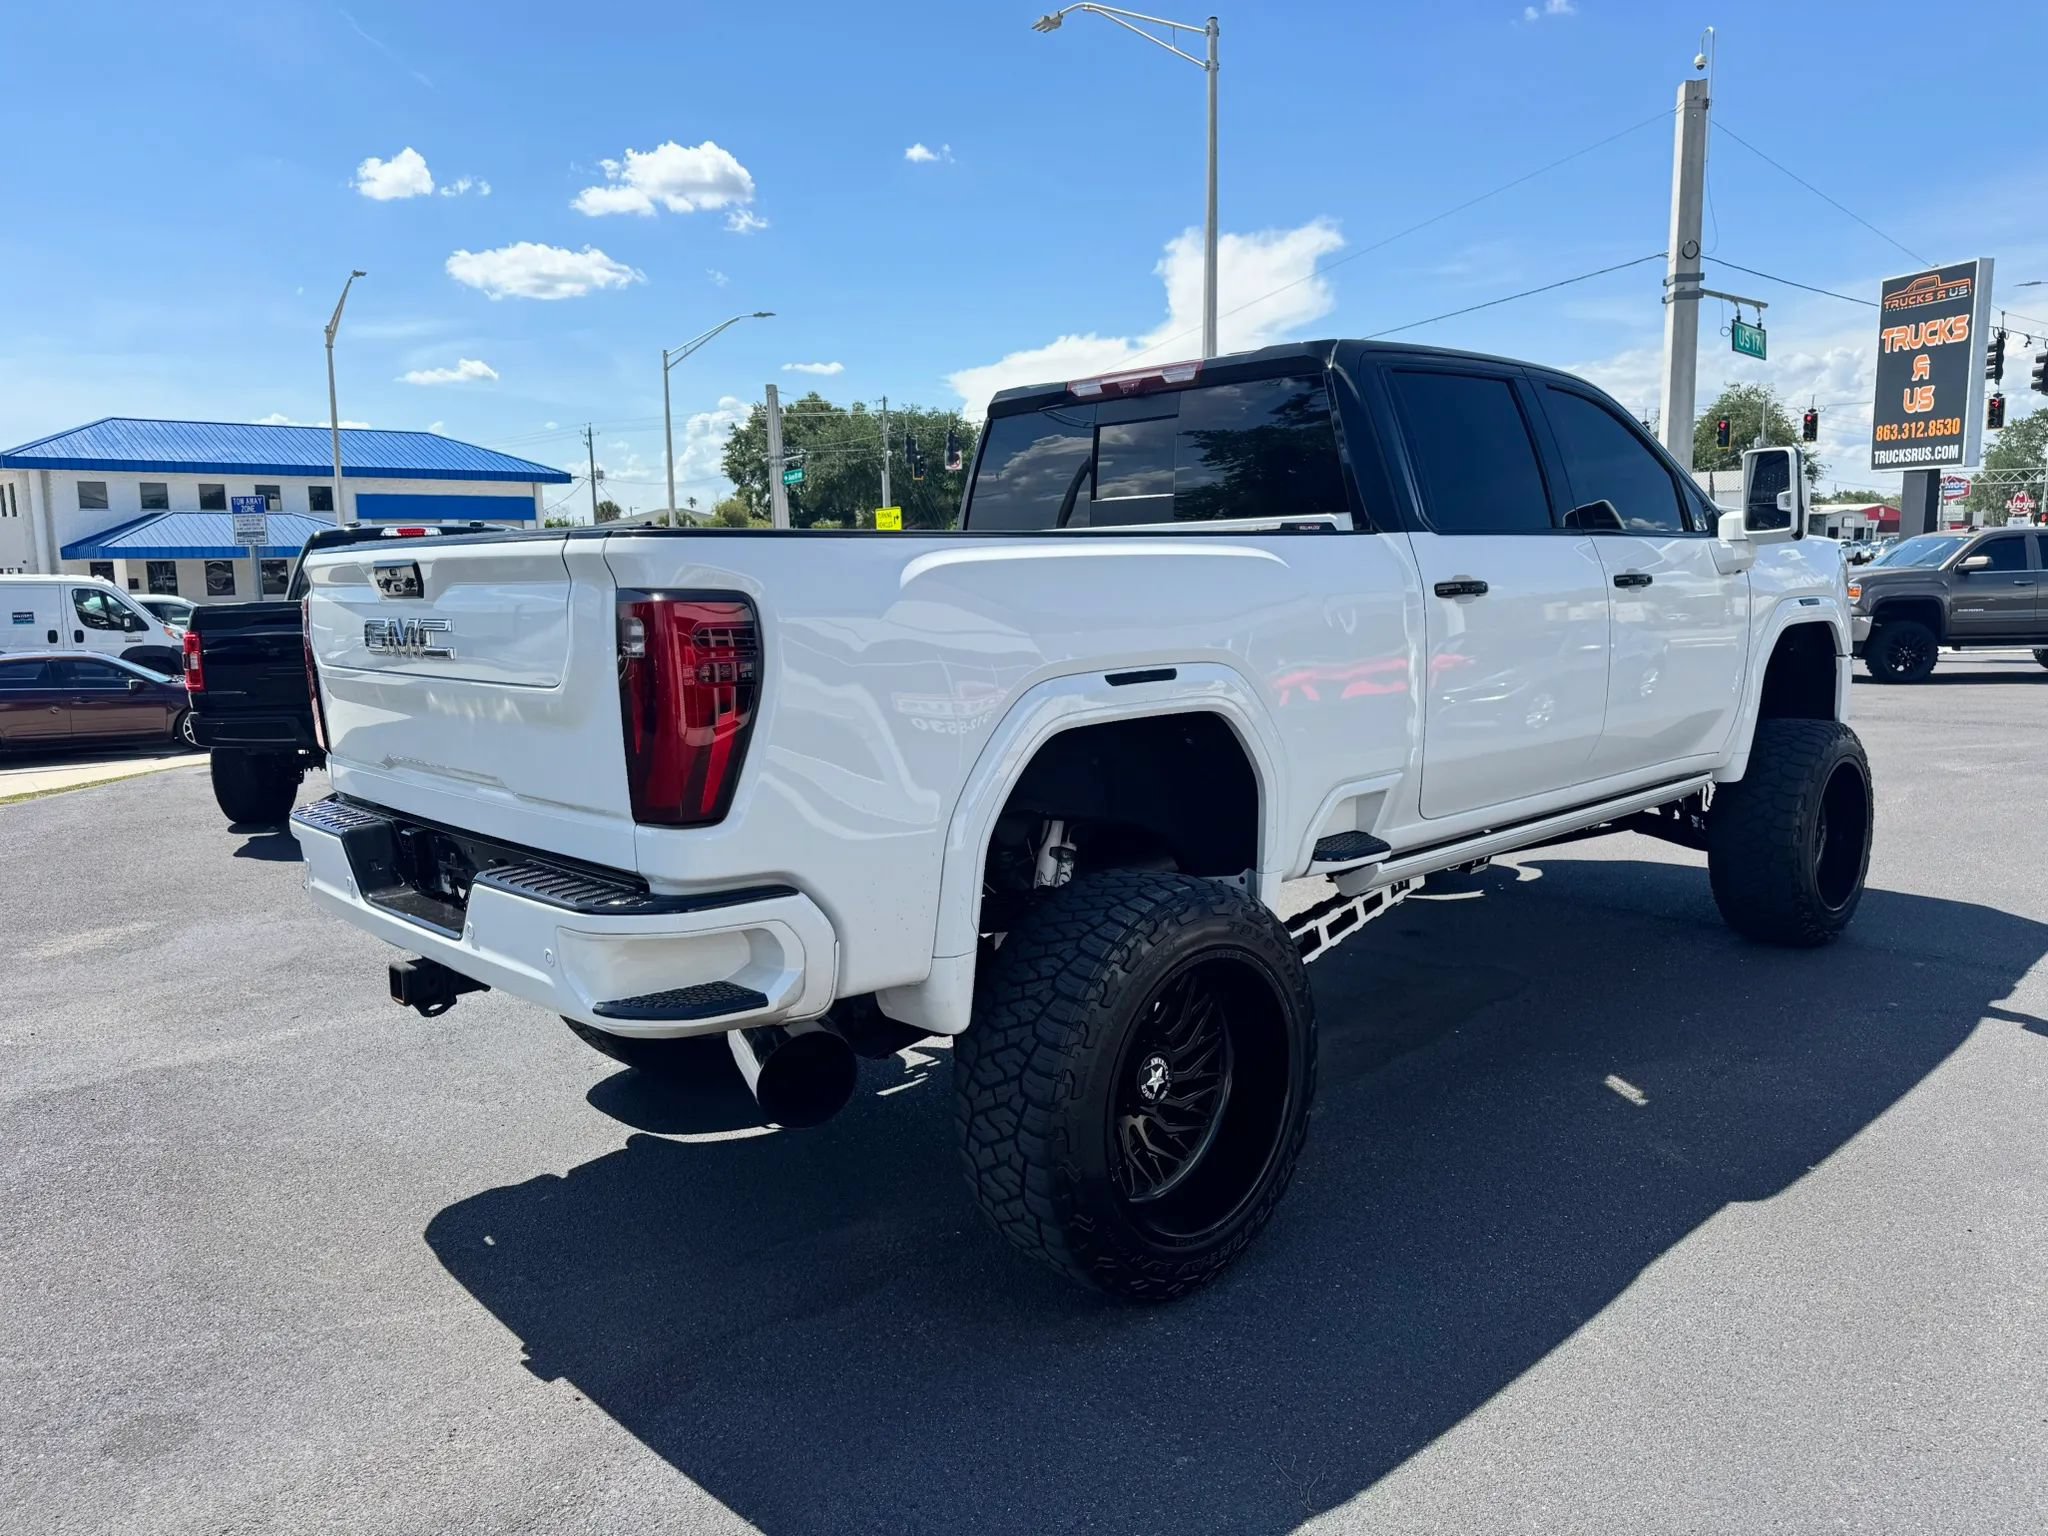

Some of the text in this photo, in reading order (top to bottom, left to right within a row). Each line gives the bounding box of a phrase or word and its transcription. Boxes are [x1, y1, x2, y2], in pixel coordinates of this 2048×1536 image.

[1884, 292, 1933, 309] TRUCKS
[1949, 285, 1968, 297] US
[1738, 329, 1761, 351] US 17
[1881, 314, 1970, 353] TRUCKS
[1903, 385, 1936, 414] US
[1875, 418, 1961, 442] 863.312.8530
[1874, 444, 1959, 465] TRUCKSRUS.COM
[363, 618, 456, 660] GMC
